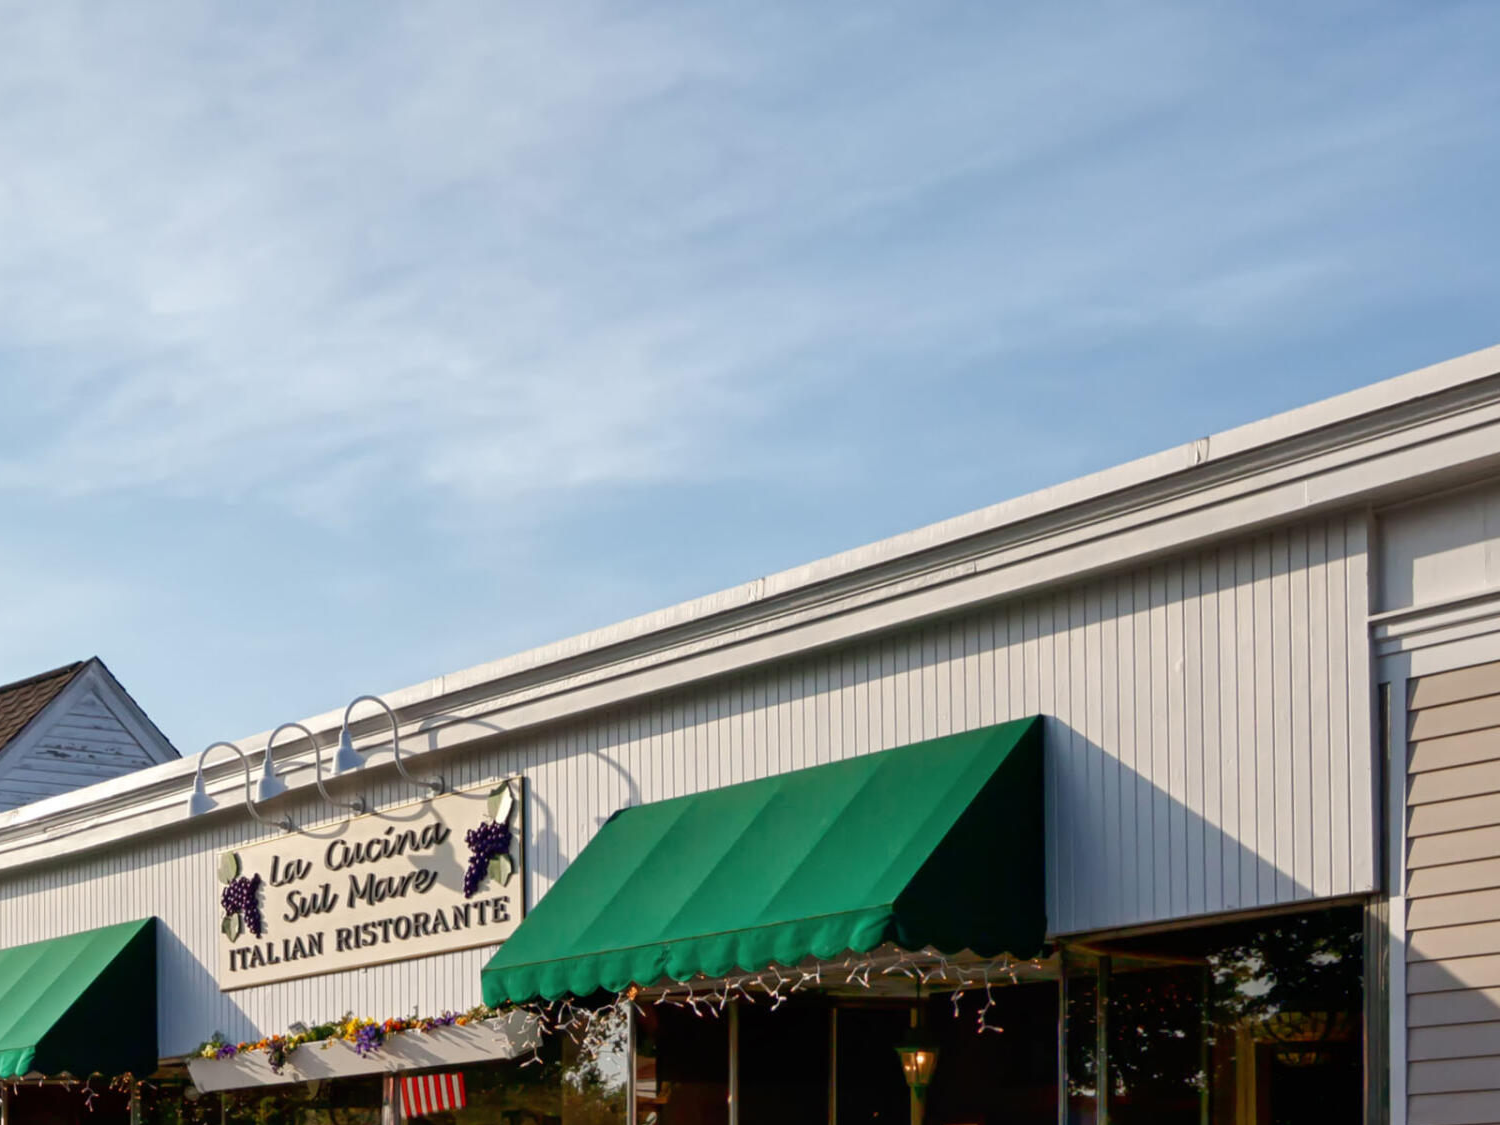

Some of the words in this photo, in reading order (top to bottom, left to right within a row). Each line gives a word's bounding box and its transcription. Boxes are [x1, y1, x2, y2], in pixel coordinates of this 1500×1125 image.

[270, 854, 312, 887] La
[324, 821, 451, 871] Cucina
[282, 882, 340, 923] Sul
[347, 867, 438, 909] Mare
[229, 931, 325, 972] ITALIAN
[335, 896, 511, 953] RISTORANTE
